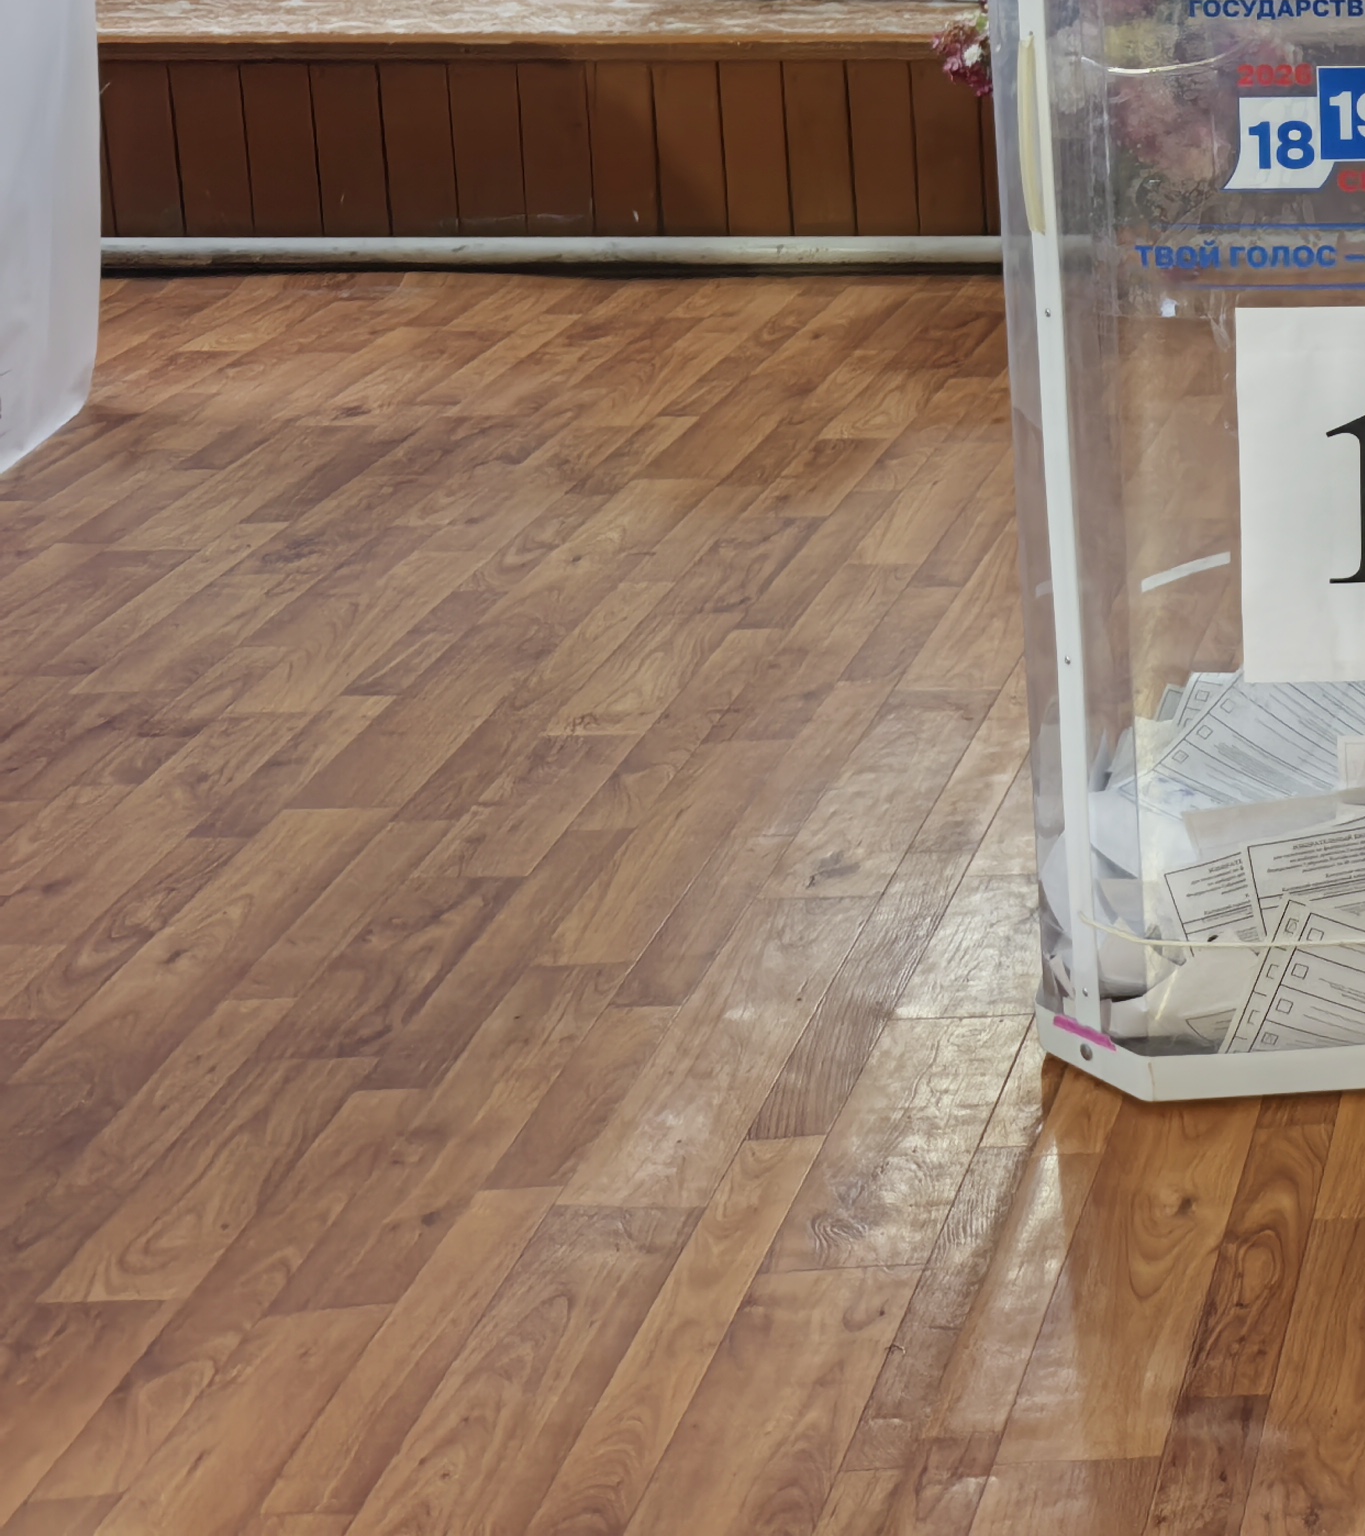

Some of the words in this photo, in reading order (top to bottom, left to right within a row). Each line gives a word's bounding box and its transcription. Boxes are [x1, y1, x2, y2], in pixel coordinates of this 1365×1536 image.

[1236, 64, 1313, 87] 2026
[1247, 120, 1316, 170] 18
[1134, 240, 1220, 268] ТВОЙ
[1229, 244, 1337, 269] ГОЛОС
